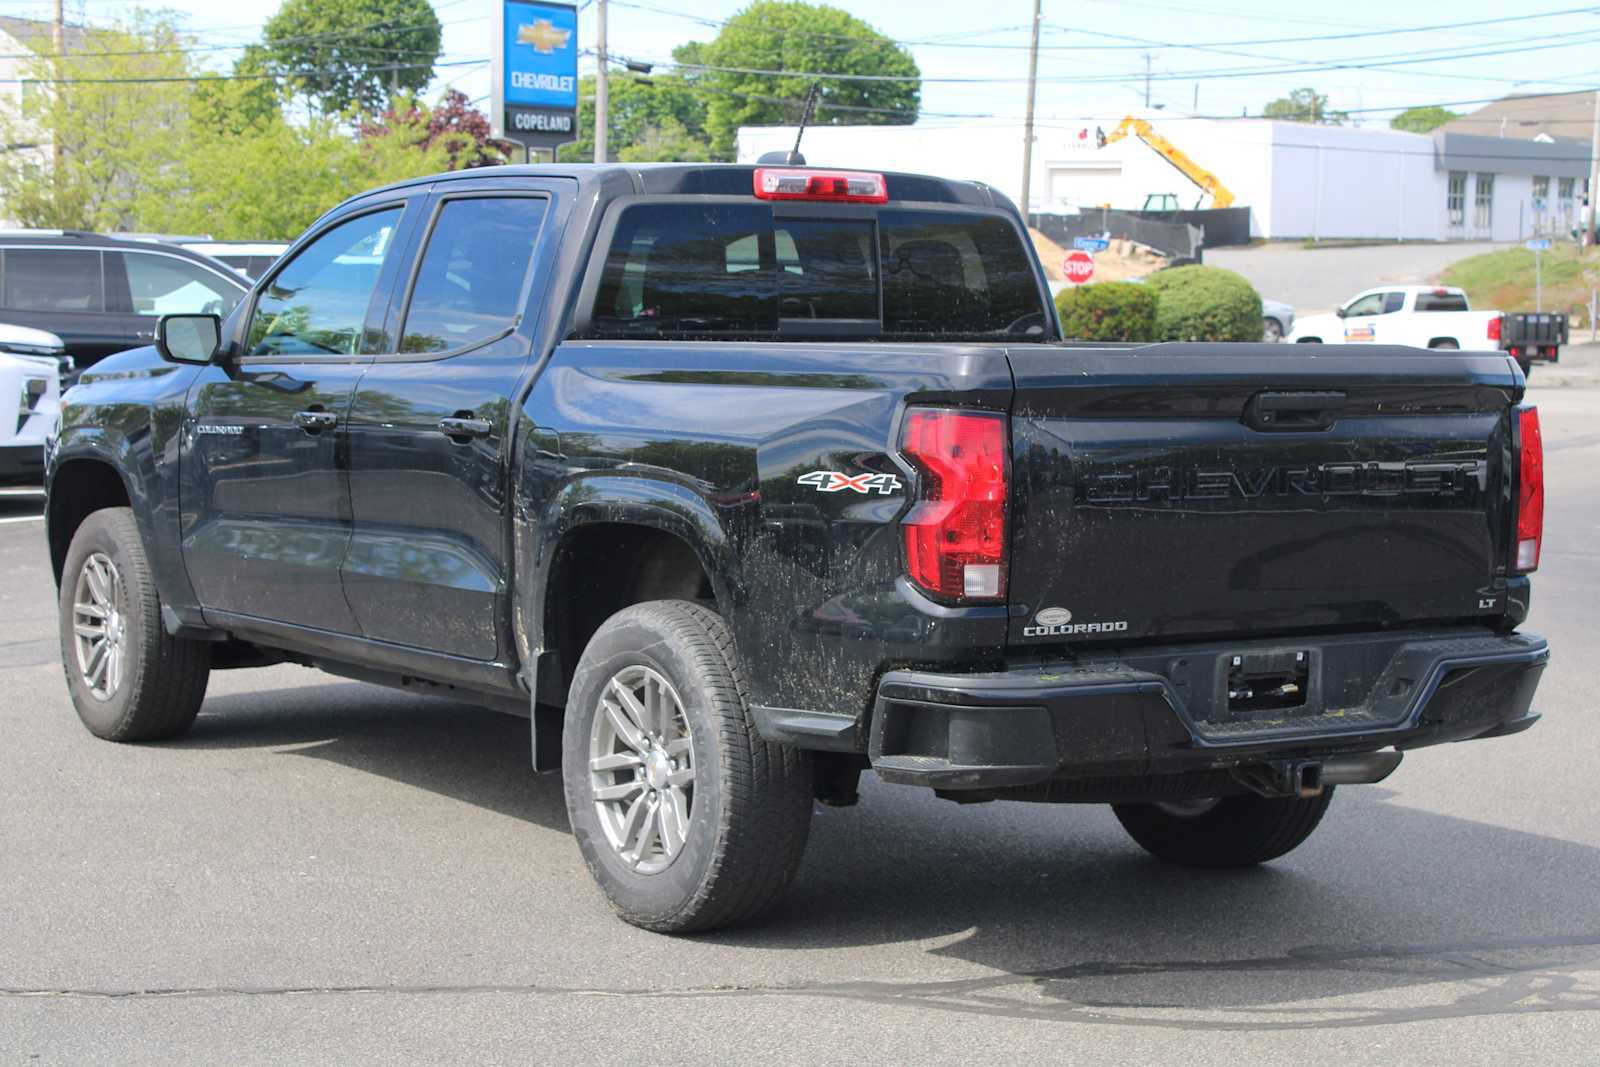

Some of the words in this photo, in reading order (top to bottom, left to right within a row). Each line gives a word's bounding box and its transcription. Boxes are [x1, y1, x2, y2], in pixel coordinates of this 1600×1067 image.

[511, 71, 574, 92] CHEVROLET
[515, 113, 571, 131] COPELAND
[1064, 260, 1093, 275] STOP
[1085, 460, 1483, 502] CHEVROLET
[1479, 599, 1496, 608] LT
[1023, 621, 1128, 636] COLORADO
